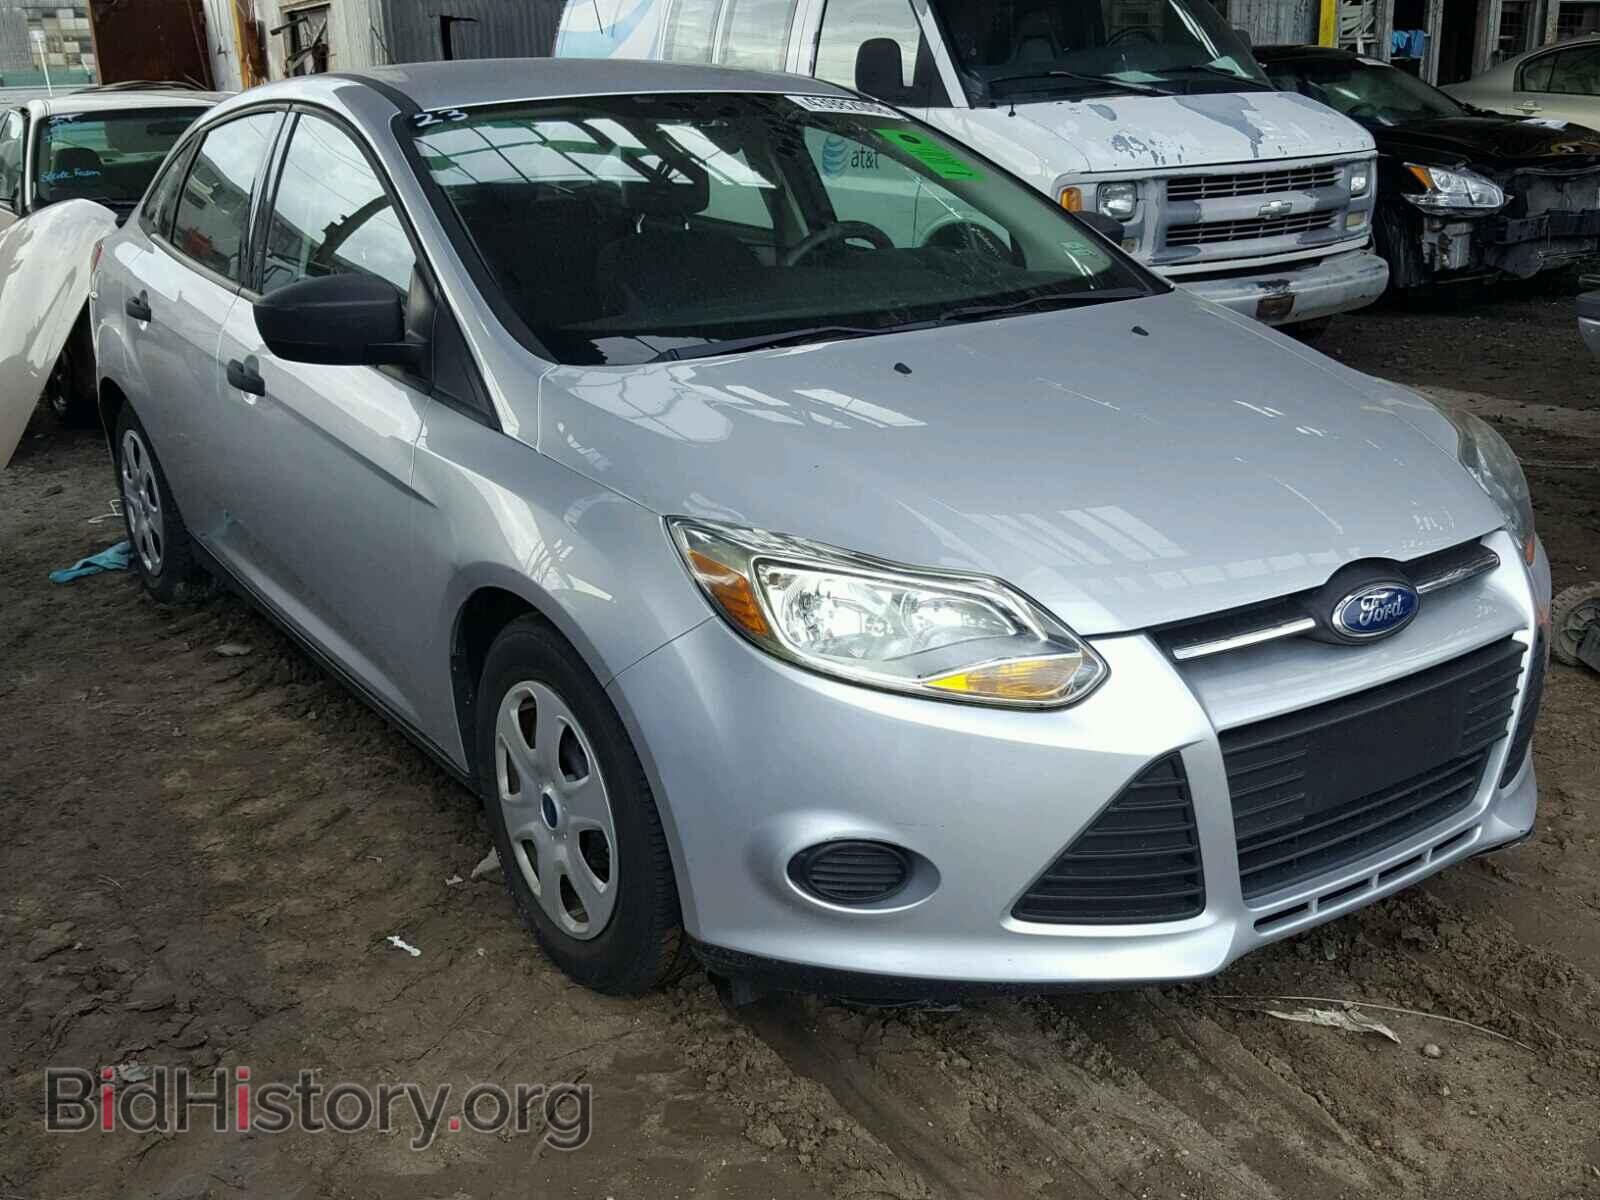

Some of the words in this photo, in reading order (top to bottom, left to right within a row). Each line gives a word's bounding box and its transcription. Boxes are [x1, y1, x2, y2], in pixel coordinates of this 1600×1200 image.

[413, 109, 469, 127] 23
[850, 146, 881, 170] at&t
[1359, 591, 1405, 627] Ford
